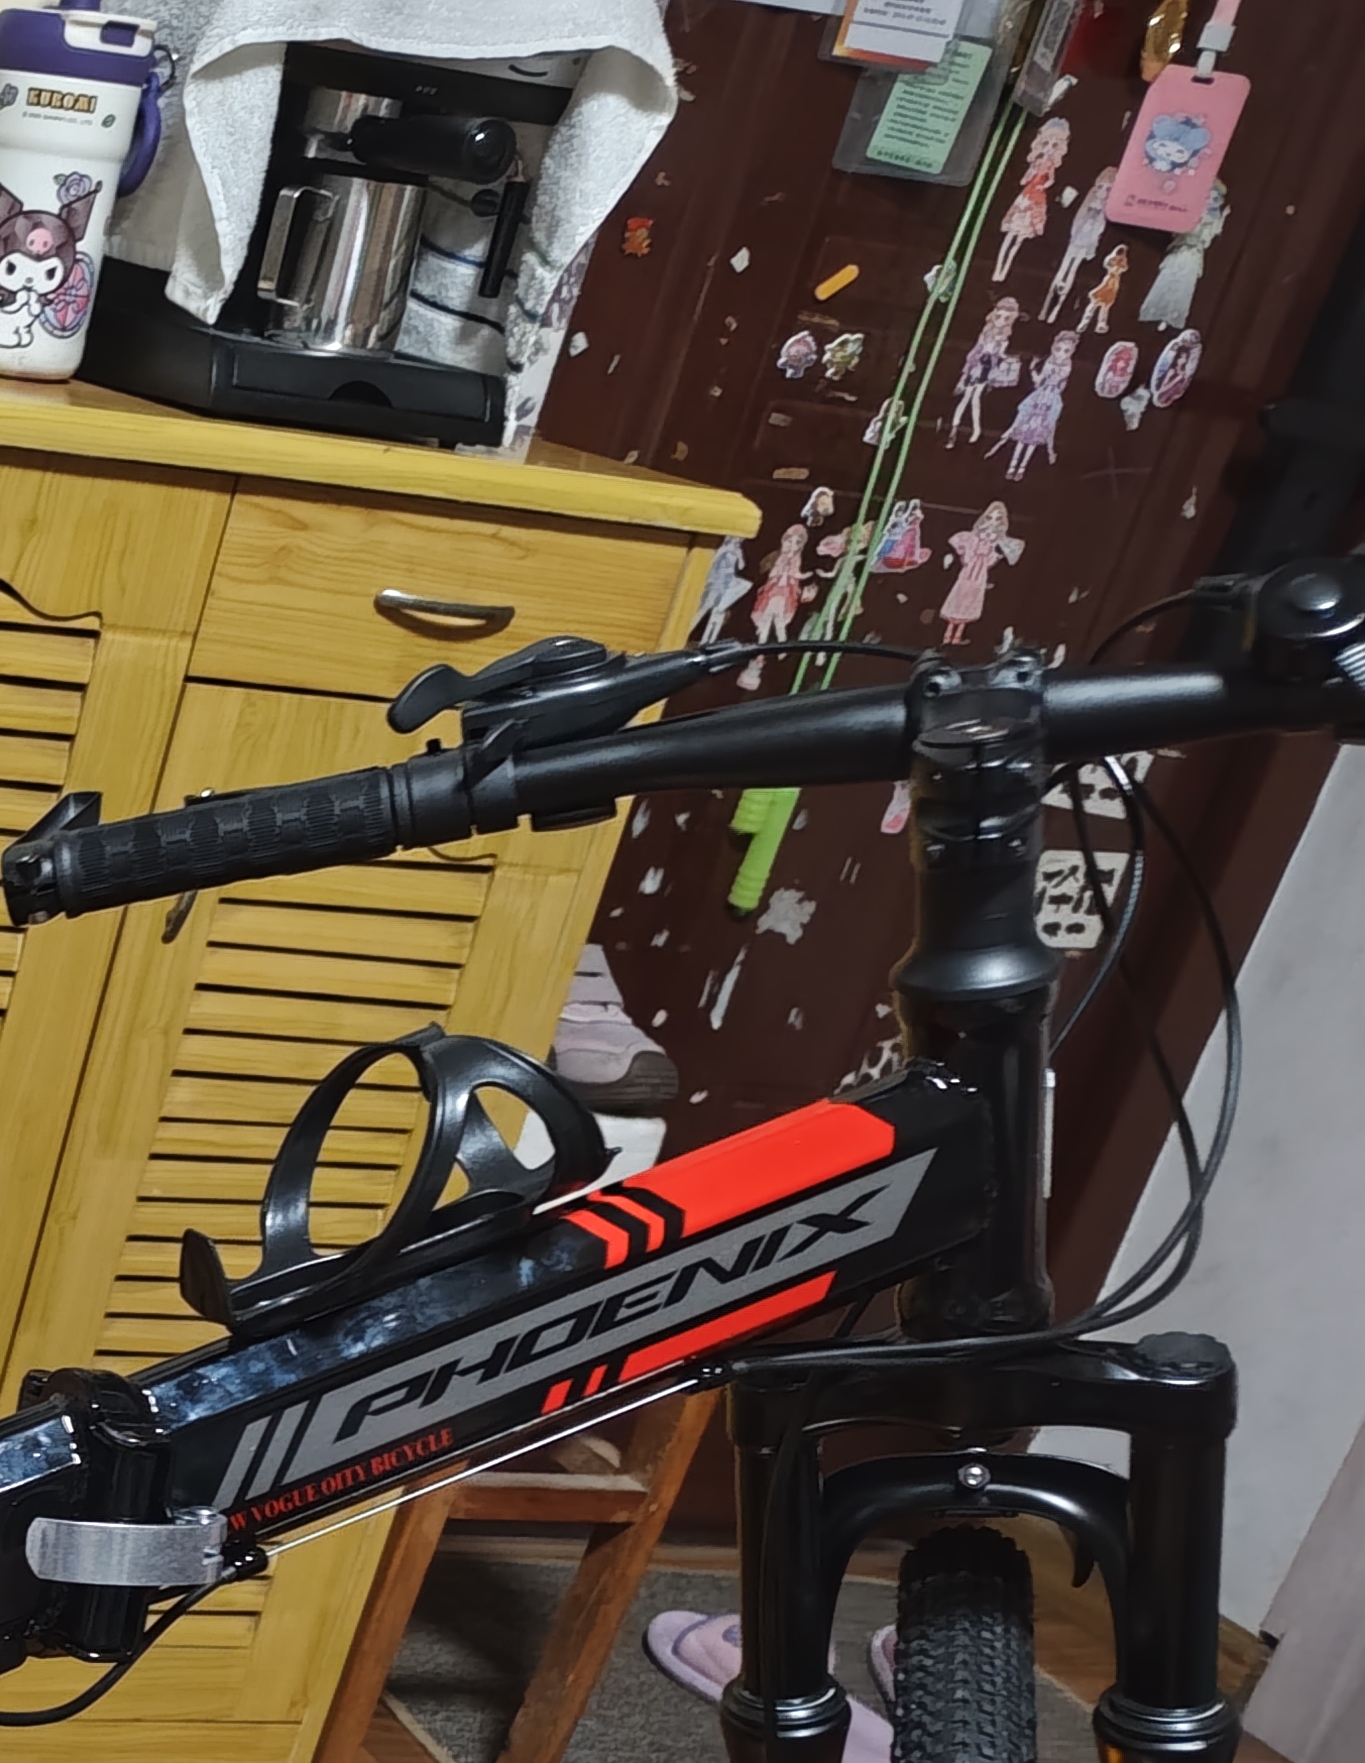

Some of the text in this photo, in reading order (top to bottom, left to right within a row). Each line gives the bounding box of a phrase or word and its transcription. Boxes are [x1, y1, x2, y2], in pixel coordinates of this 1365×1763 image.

[27, 87, 98, 113] KUROMI
[335, 1181, 893, 1442] PHOENIX
[251, 1483, 318, 1522] VOGUE
[370, 1428, 454, 1477] BICYCLE
